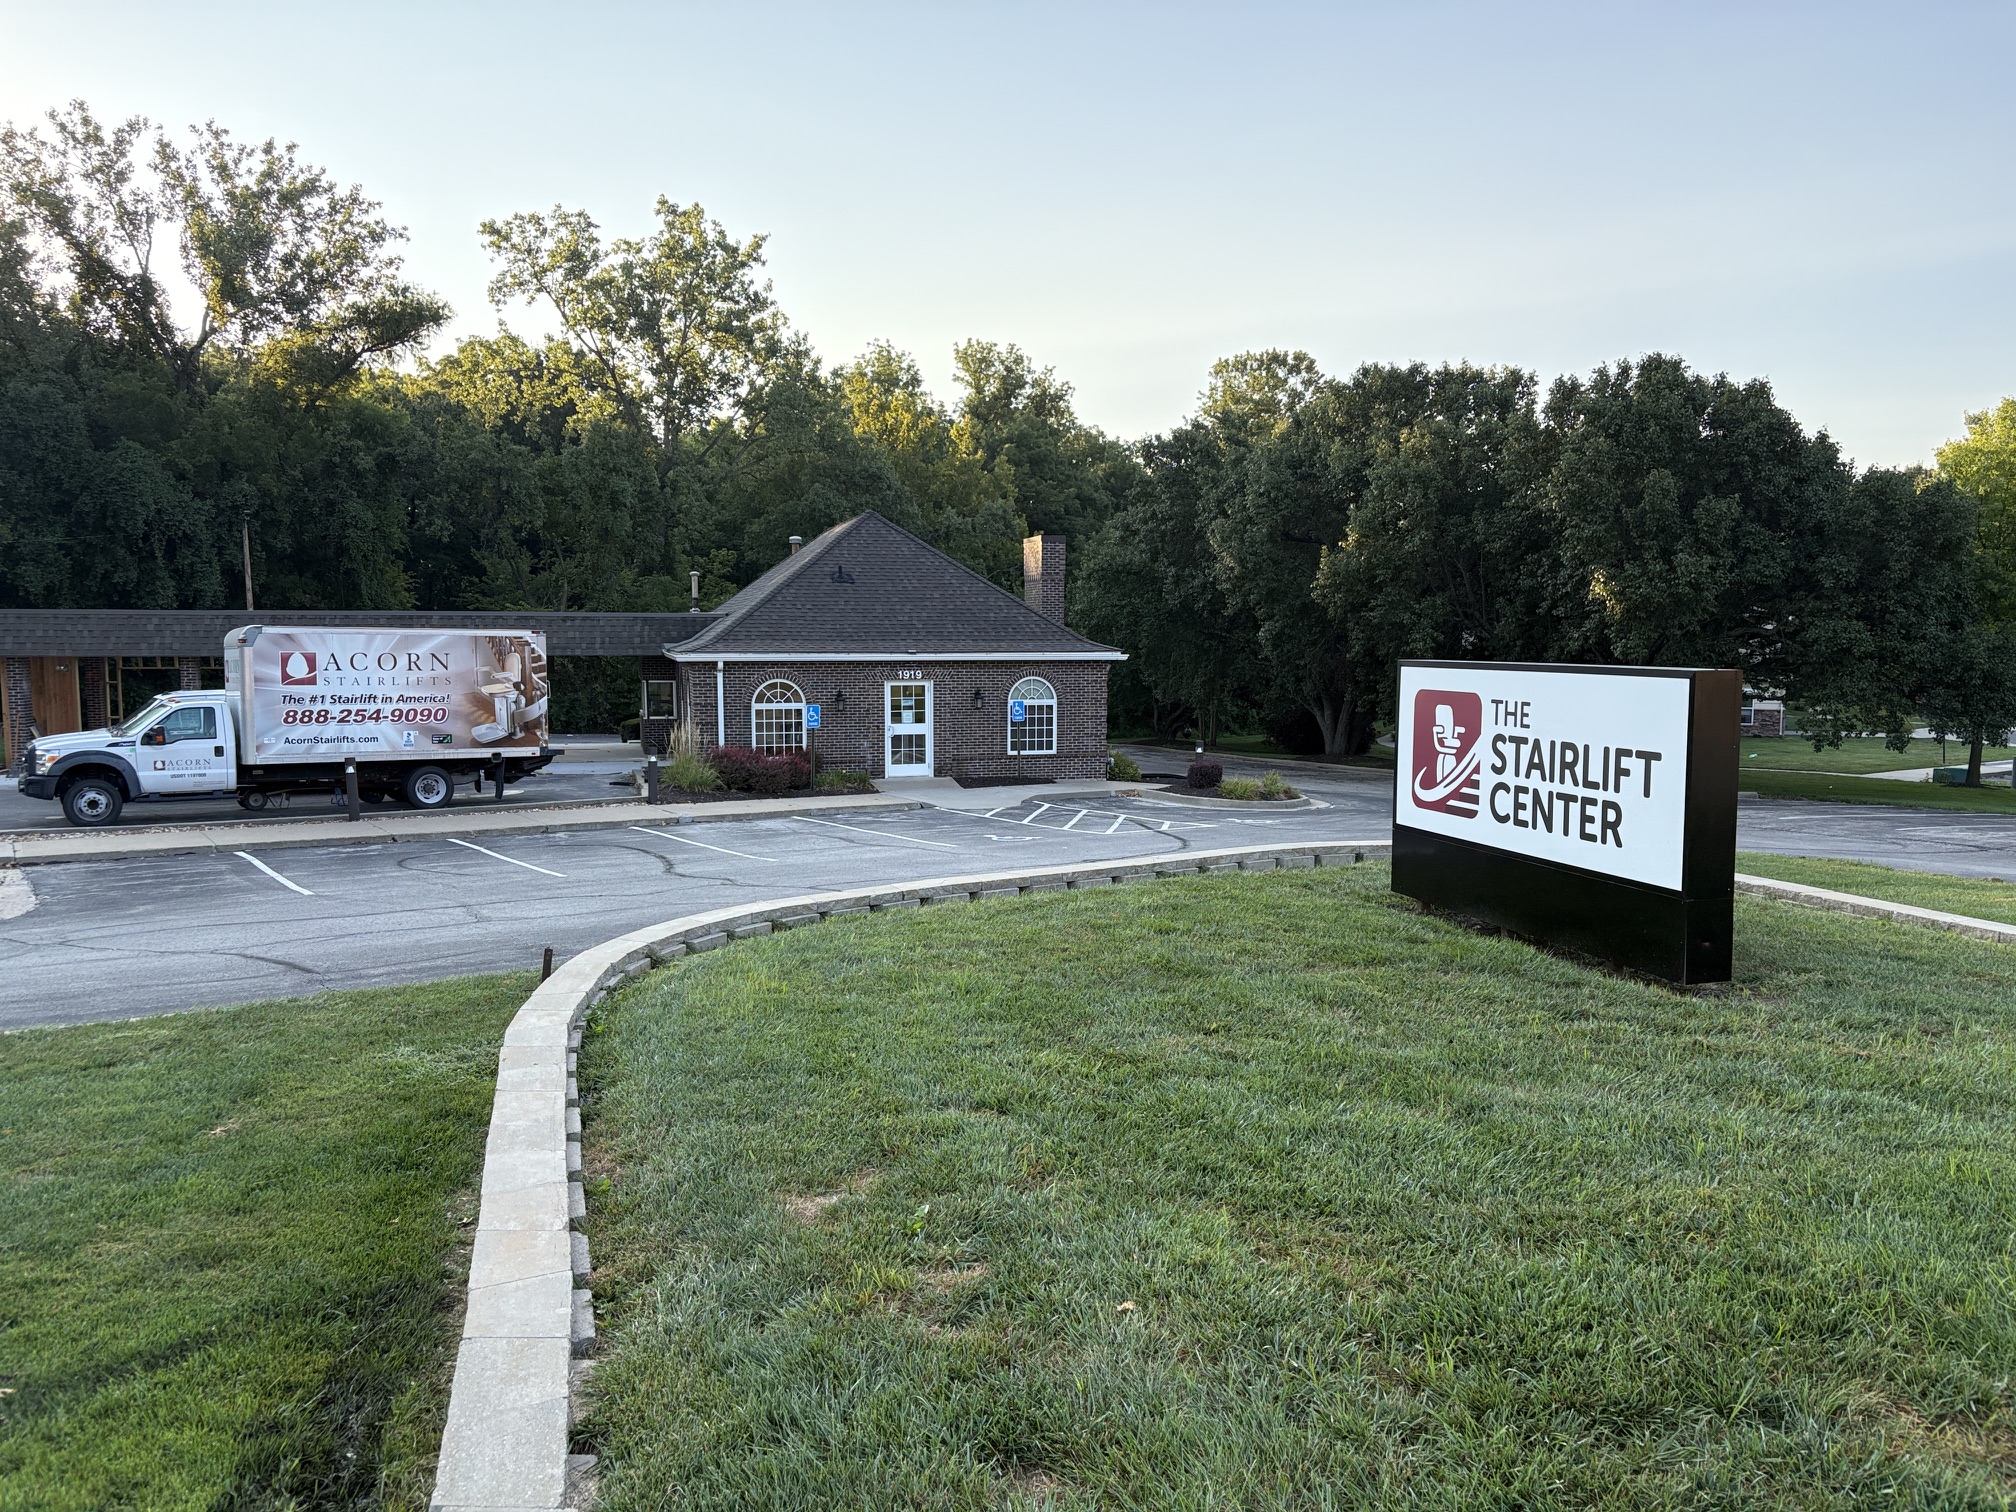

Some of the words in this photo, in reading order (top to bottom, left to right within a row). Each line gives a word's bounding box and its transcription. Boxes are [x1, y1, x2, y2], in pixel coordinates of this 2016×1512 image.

[323, 652, 450, 672] ACORN
[323, 676, 452, 686] STAIRLIFTS
[898, 670, 922, 679] 1919
[281, 695, 305, 705] The
[308, 695, 326, 705] #1
[329, 694, 380, 704] Stairlift
[381, 694, 393, 704] in
[396, 694, 450, 704] America!
[282, 707, 448, 725] 888-254-9090
[1490, 699, 1531, 729] THE
[283, 735, 379, 745] AcornStairlifts.com
[1490, 733, 1662, 799] STAIRLIFT
[1490, 781, 1623, 848] CENTER
